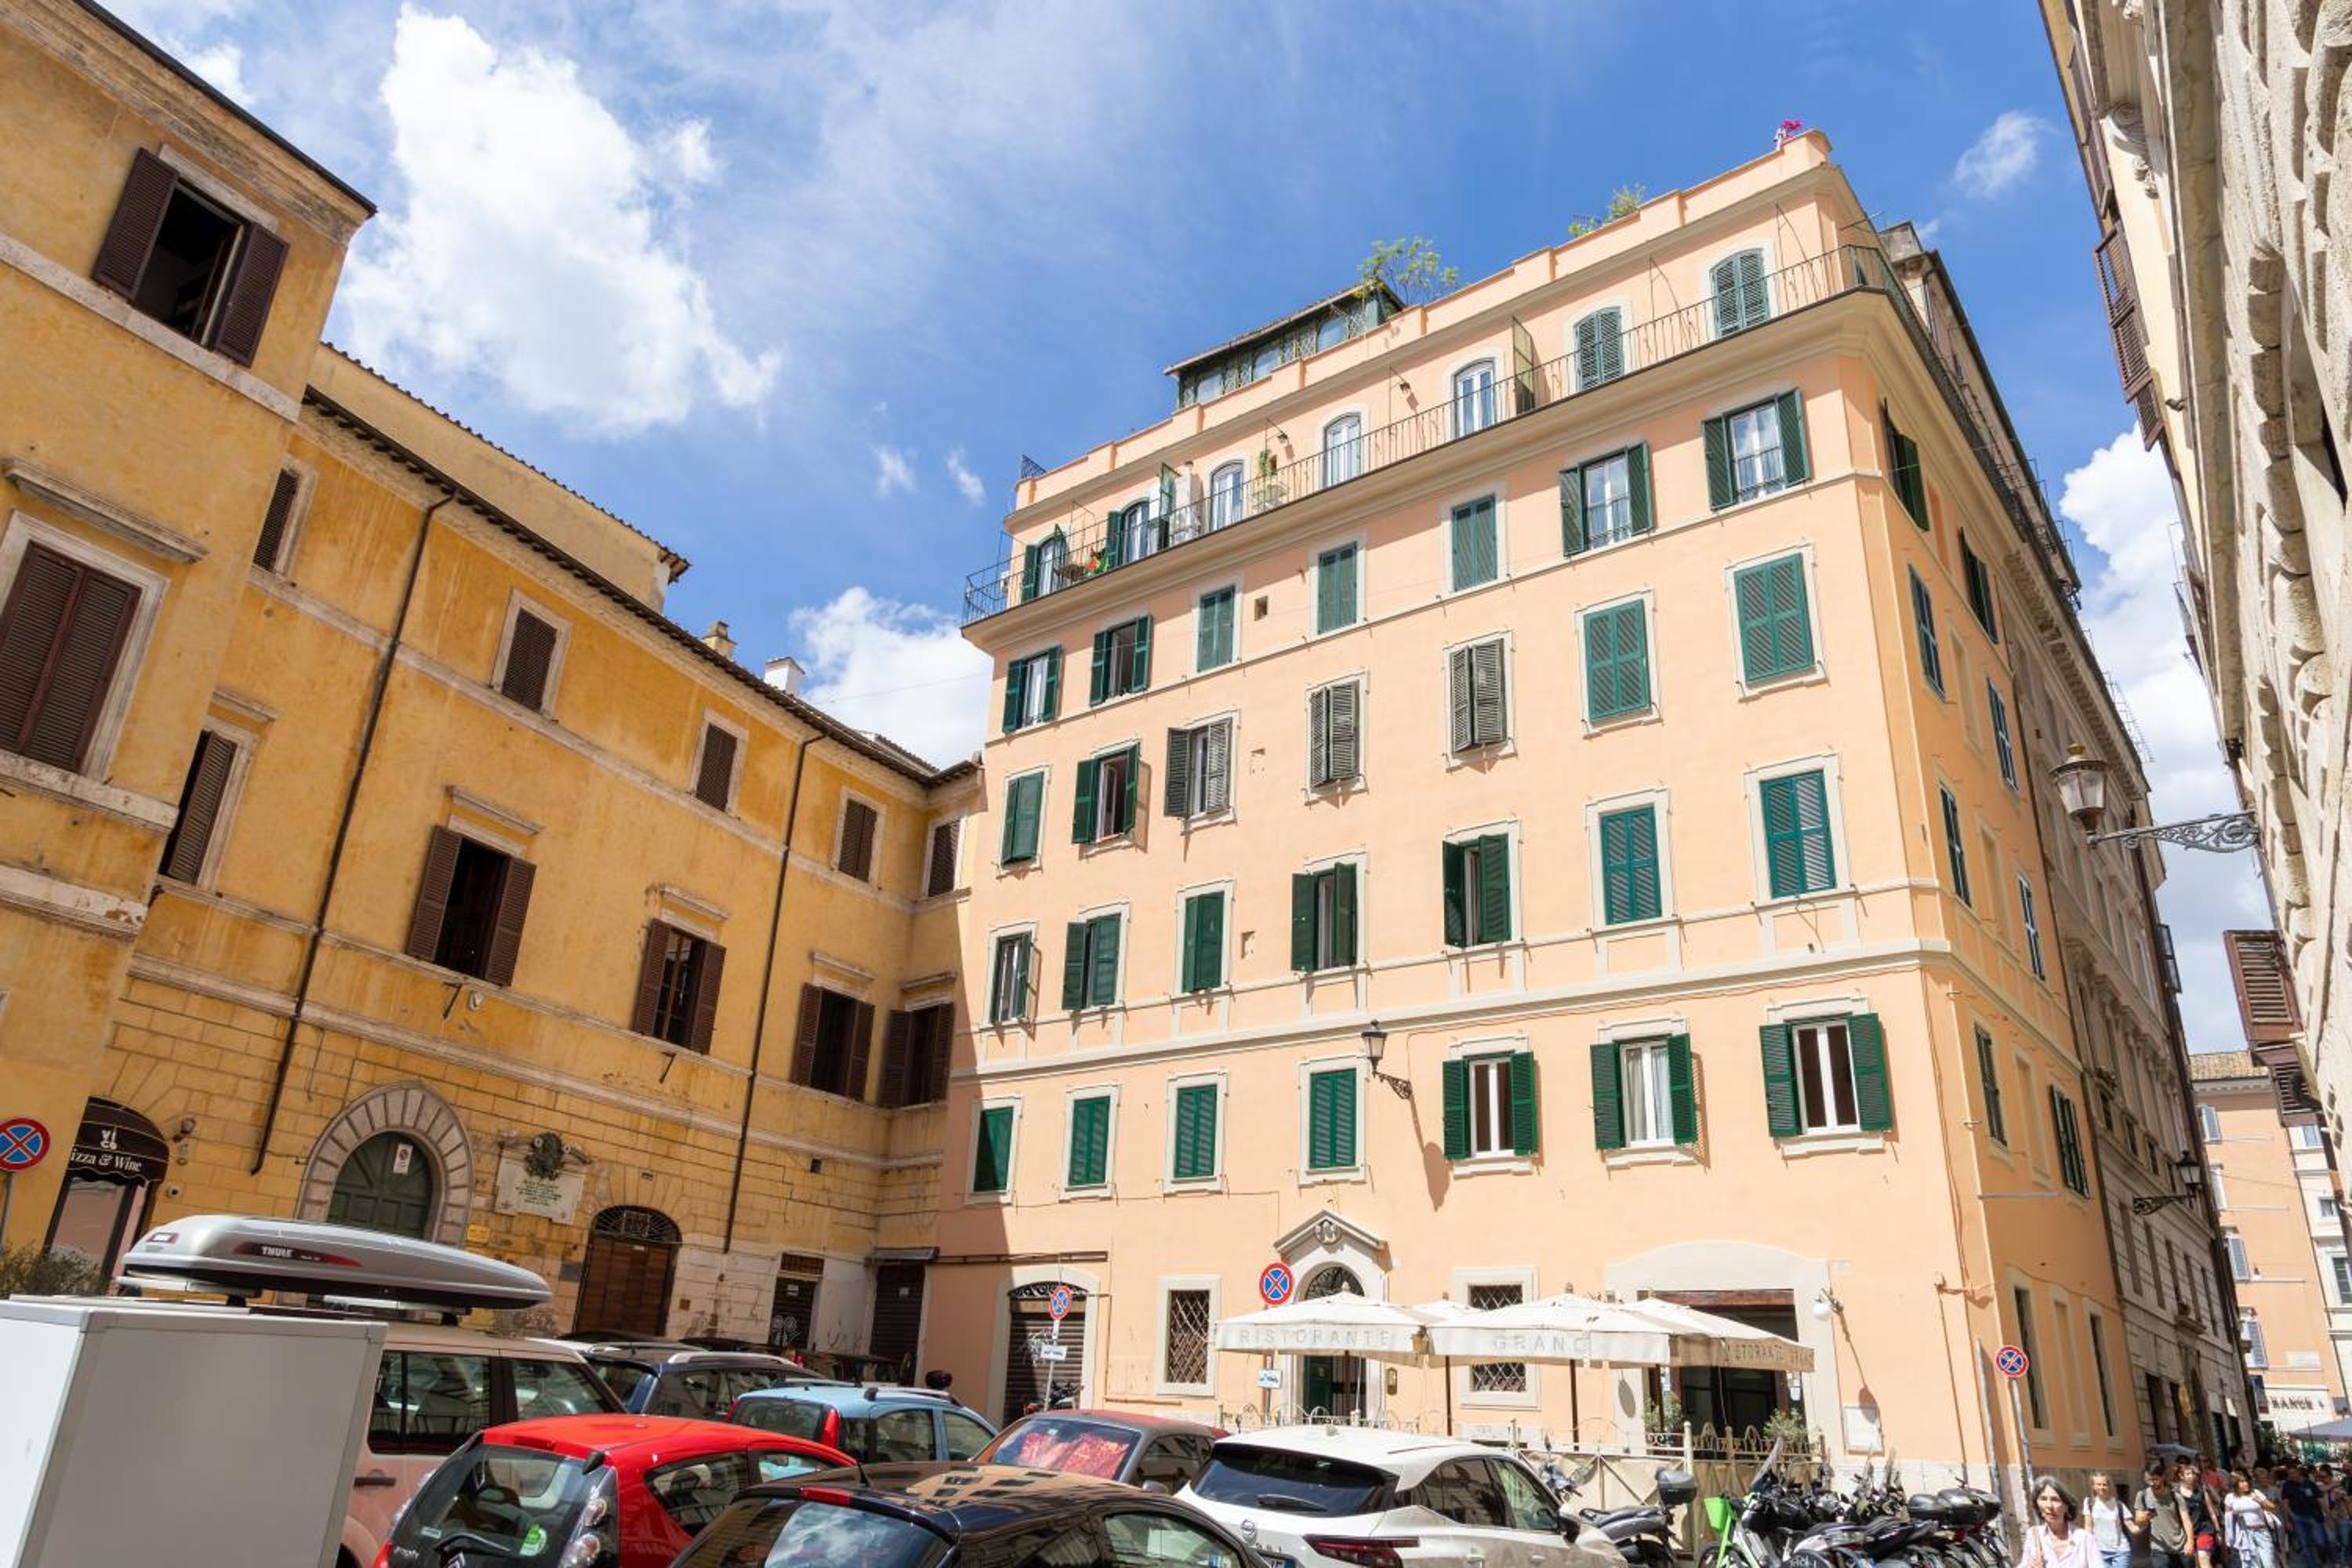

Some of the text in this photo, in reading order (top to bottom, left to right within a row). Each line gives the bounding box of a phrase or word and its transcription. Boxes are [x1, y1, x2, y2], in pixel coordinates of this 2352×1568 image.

[71, 1149, 142, 1172] izza & Wine
[262, 1246, 292, 1258] THULE
[1240, 1329, 1392, 1346] RISTORANTE
